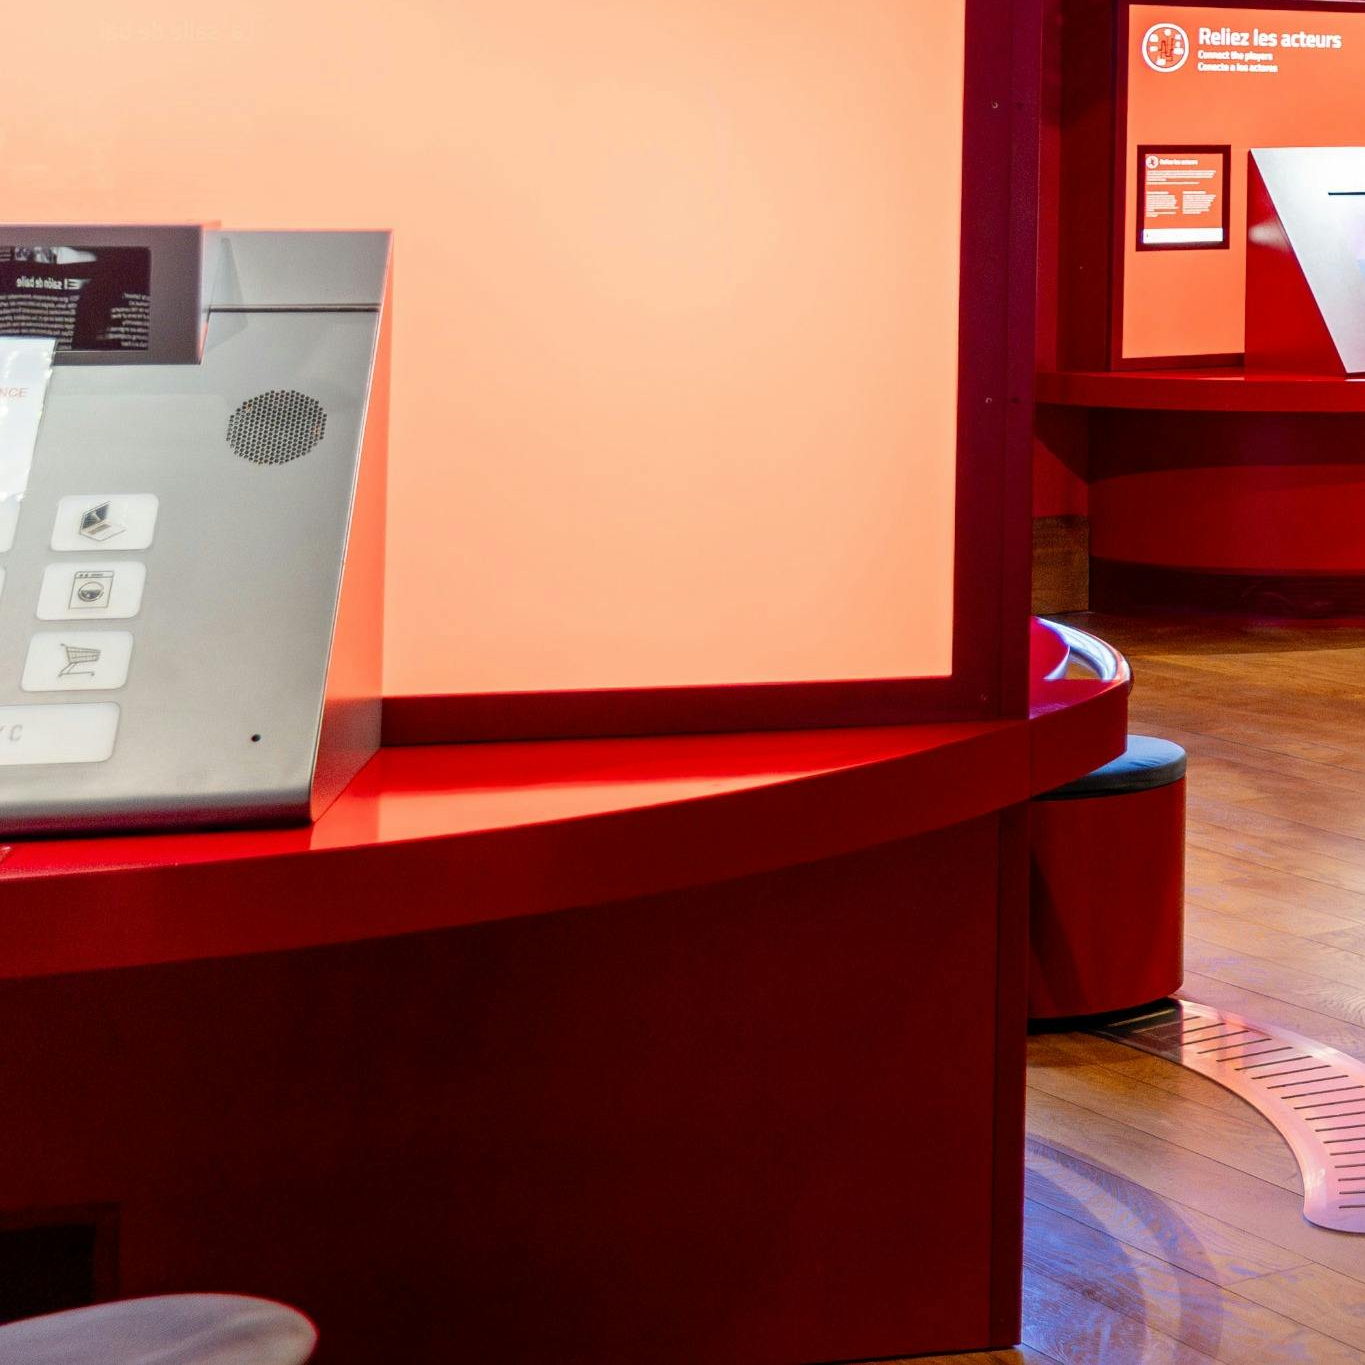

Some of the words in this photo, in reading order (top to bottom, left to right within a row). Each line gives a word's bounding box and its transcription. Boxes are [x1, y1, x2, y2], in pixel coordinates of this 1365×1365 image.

[1198, 27, 1250, 46] Reliez
[1253, 27, 1278, 47] les
[1280, 31, 1342, 49] acteurs
